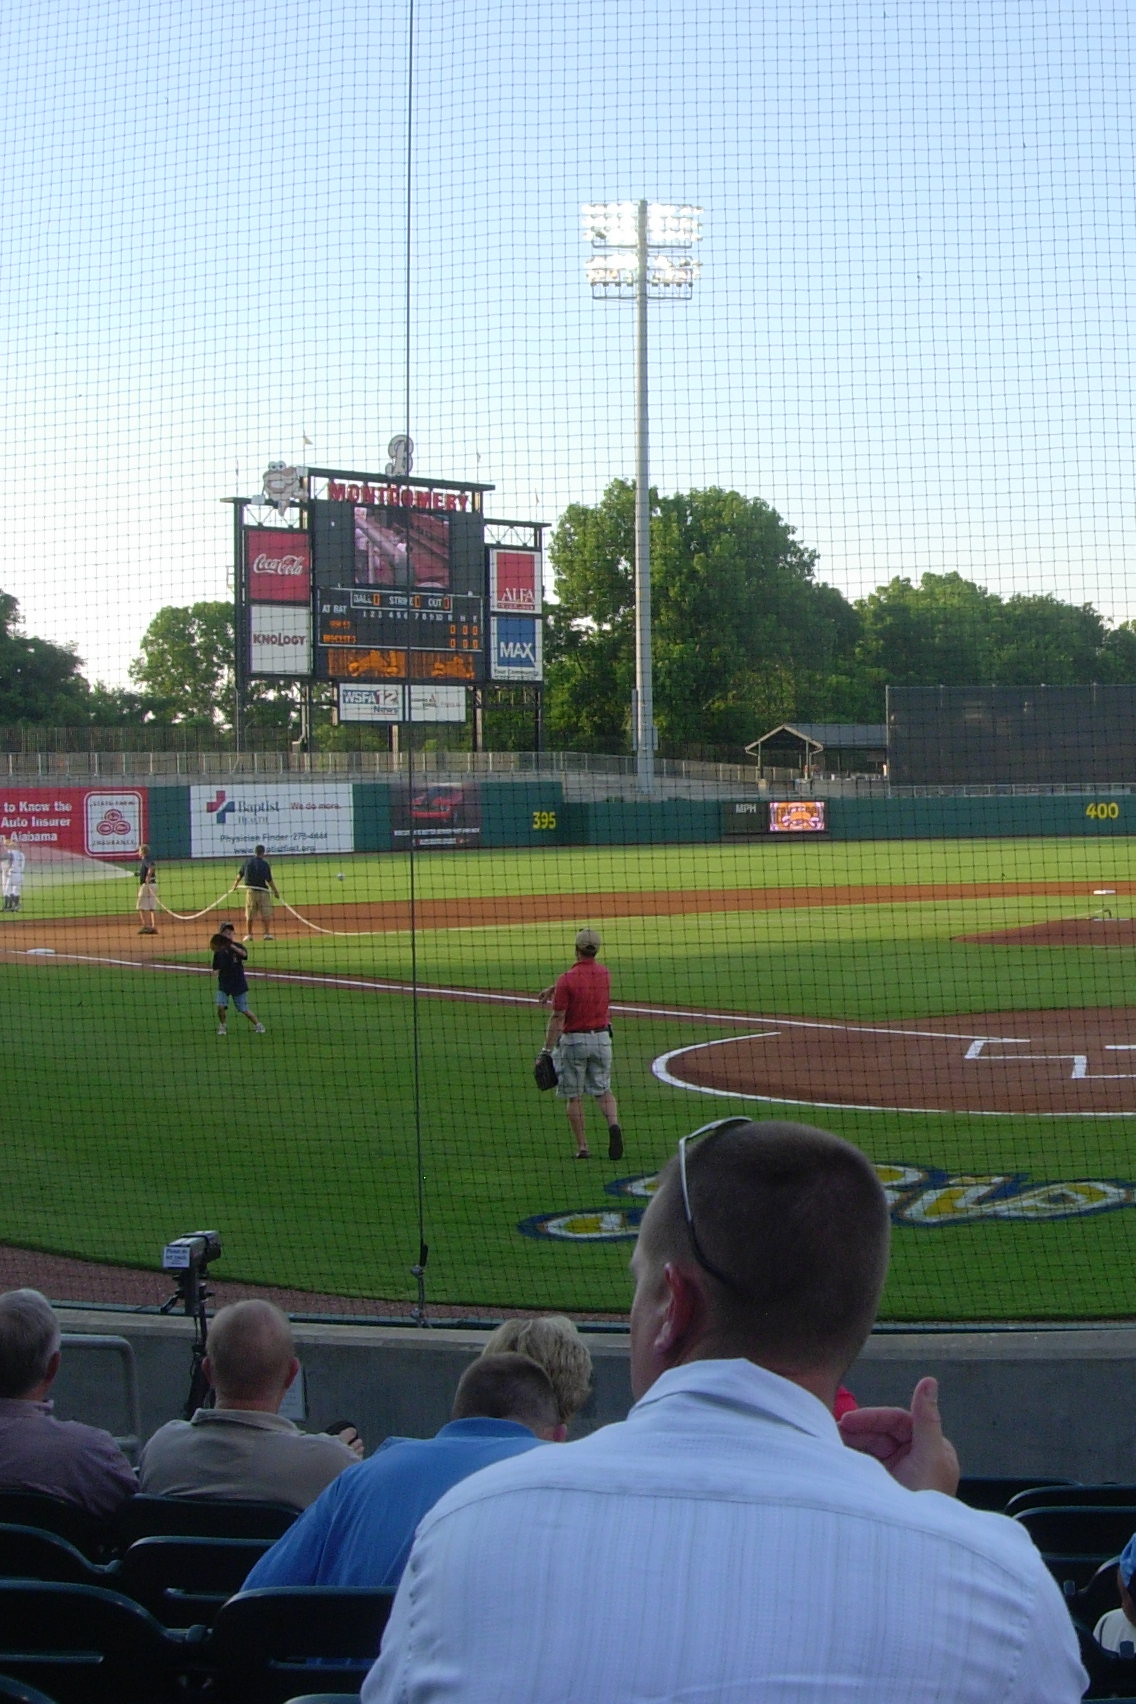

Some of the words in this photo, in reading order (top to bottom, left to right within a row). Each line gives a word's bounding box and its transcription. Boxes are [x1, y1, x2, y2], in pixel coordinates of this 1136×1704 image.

[327, 480, 469, 512] MONTGOMERY
[353, 594, 372, 604] BALL
[389, 596, 413, 606] STRIE
[502, 588, 534, 602] ALFA
[322, 604, 330, 613] AT
[333, 604, 347, 614] BAT
[253, 632, 306, 646] KNOLOGY
[500, 642, 535, 664] MAX
[343, 691, 378, 704] WSFA
[4, 802, 16, 812] to
[20, 802, 49, 812] Know
[54, 801, 72, 812] the
[238, 801, 280, 816] Baptist
[735, 803, 757, 813] MPH
[1086, 803, 1119, 819] 400
[1, 817, 28, 828] Auto
[31, 816, 71, 827] Insurer
[532, 811, 557, 829] 395
[10, 831, 58, 842] Alabama
